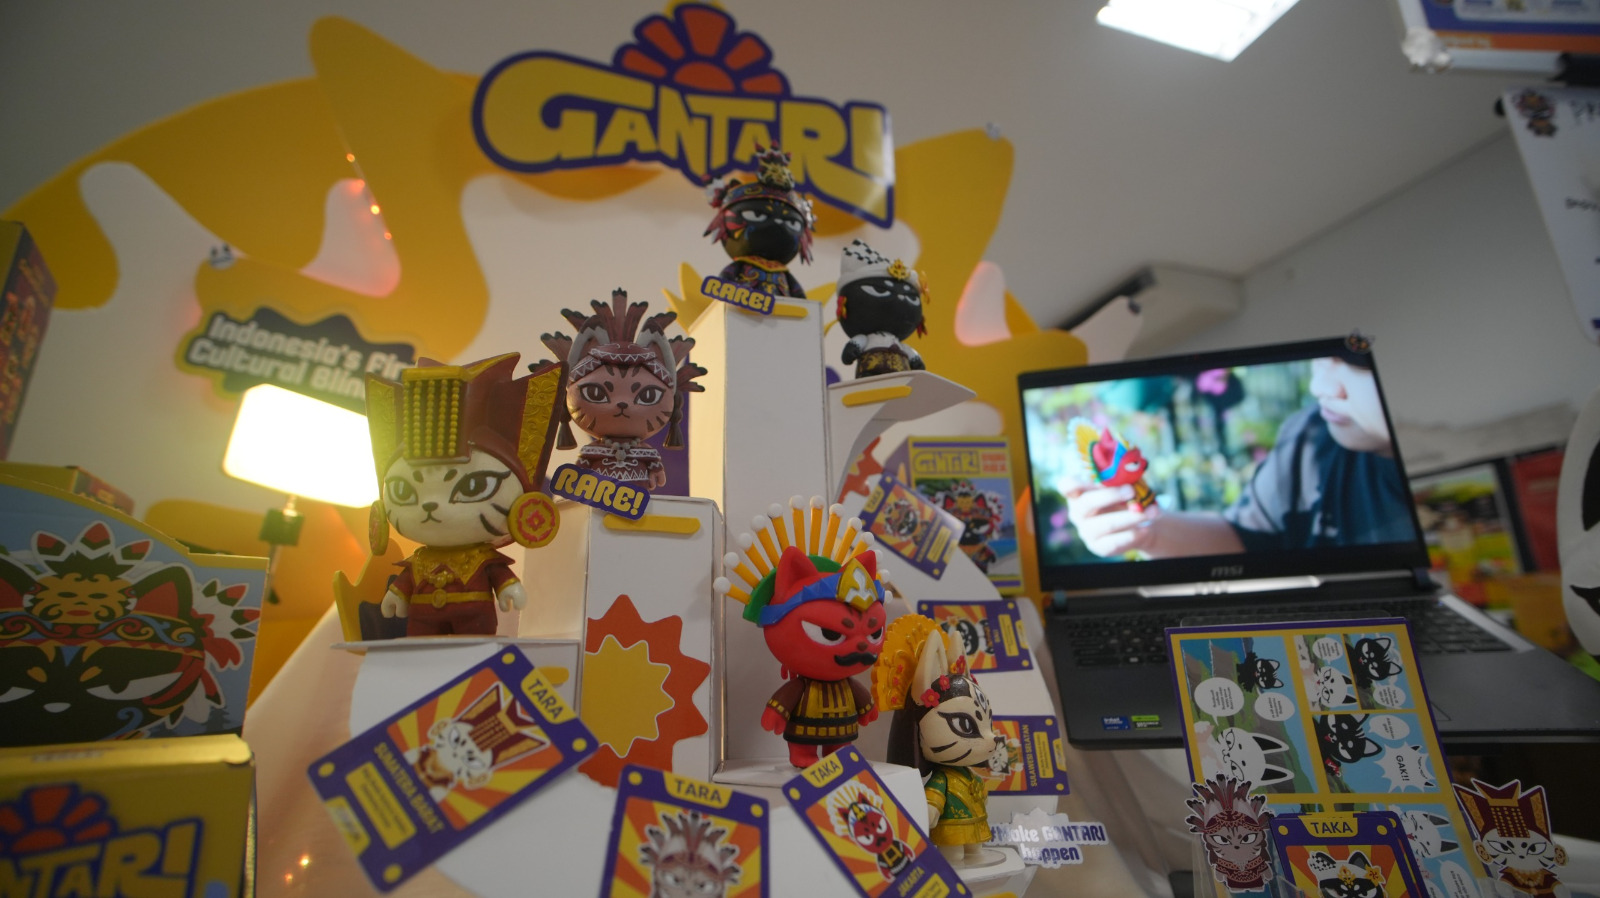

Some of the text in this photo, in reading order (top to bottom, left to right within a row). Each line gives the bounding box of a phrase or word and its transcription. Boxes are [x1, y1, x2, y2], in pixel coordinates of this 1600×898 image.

[474, 50, 895, 228] GANTARI
[703, 280, 773, 312] RARE!
[208, 315, 363, 370] Indonesia's
[188, 338, 366, 401] Cultural Blin
[554, 468, 645, 516] RARE!
[527, 678, 564, 720] TARA
[374, 741, 415, 803] SUMATERA
[809, 760, 841, 785] TAKA
[1022, 724, 1038, 787] SULAWESI SELATAN
[1395, 754, 1409, 782] GAK!!
[673, 780, 723, 804] TARA
[1041, 825, 1106, 842] GANTARI
[1310, 820, 1353, 835] TAKA
[1020, 843, 1080, 864] happen
